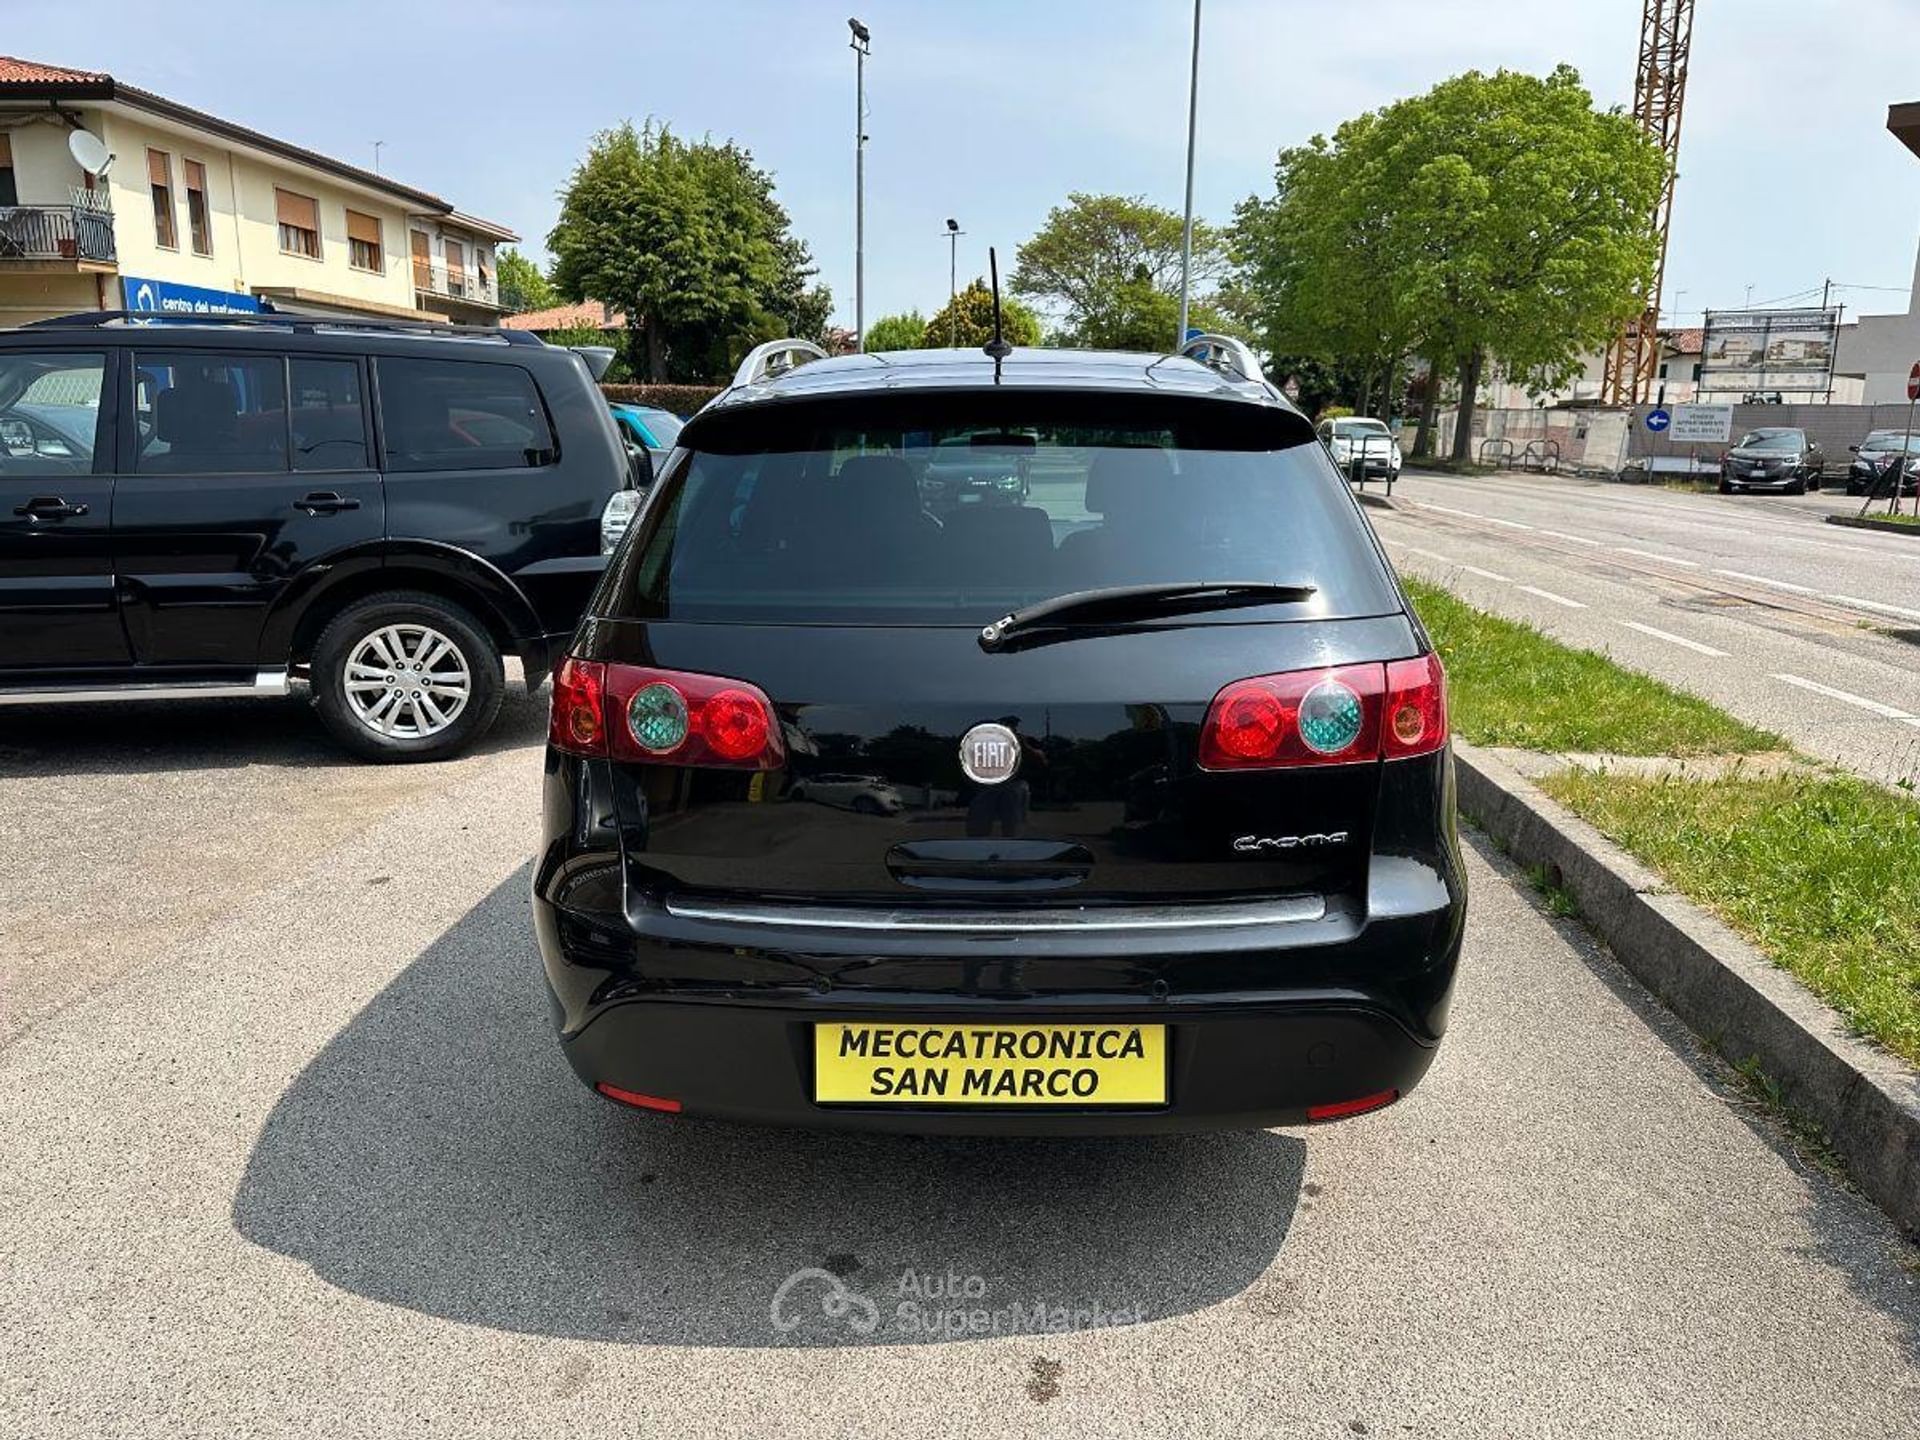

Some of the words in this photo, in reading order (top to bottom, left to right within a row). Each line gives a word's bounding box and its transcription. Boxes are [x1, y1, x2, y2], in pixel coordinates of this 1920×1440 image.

[162, 298, 193, 313] centro
[195, 300, 208, 313] del
[974, 742, 1007, 768] FIAT
[1233, 831, 1348, 851] Croma
[838, 1029, 1146, 1059] MECCATRONICA
[870, 1067, 948, 1097] SAN
[961, 1068, 1099, 1097] MARCO
